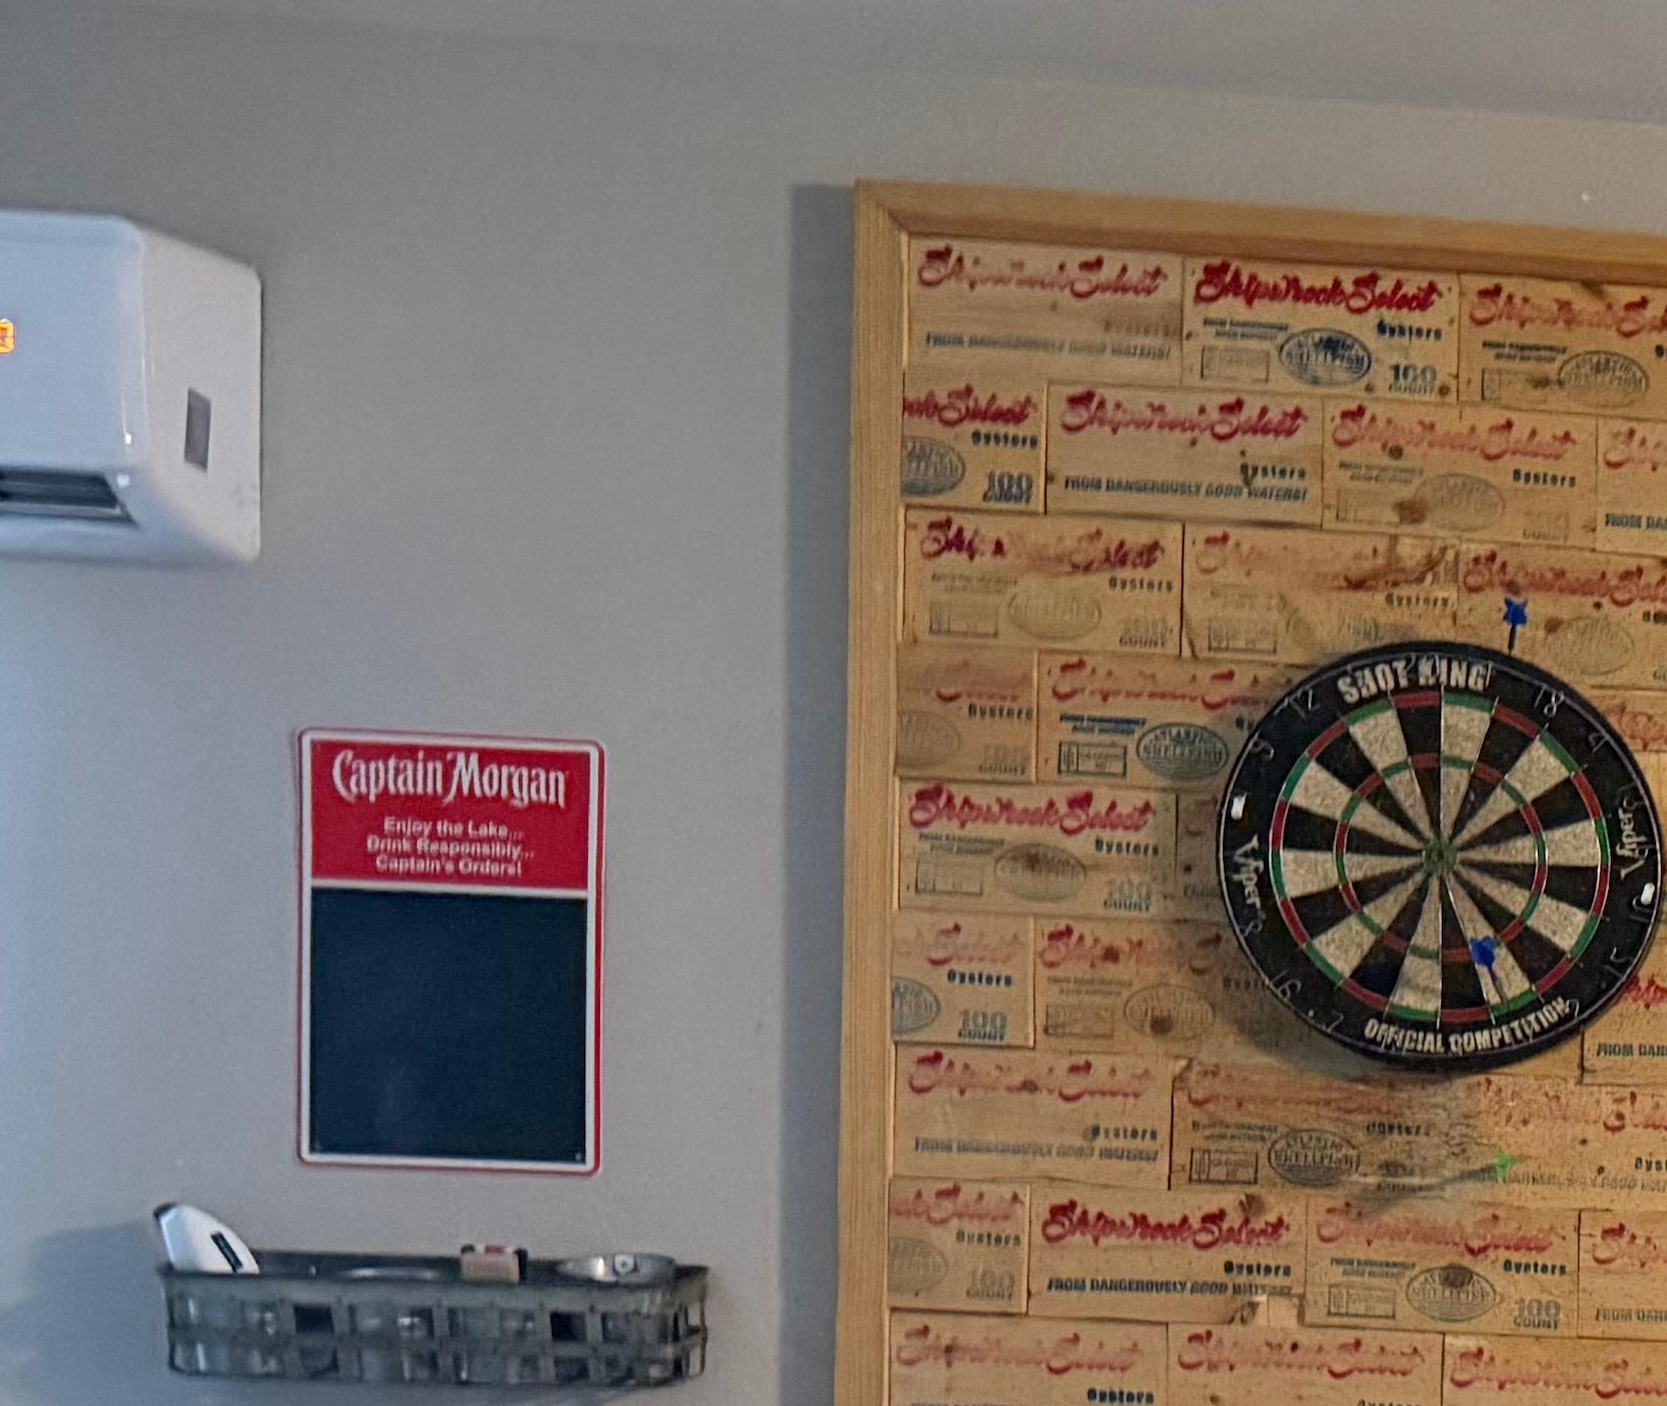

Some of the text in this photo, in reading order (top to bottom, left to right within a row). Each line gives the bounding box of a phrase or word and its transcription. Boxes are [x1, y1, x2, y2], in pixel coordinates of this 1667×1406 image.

[1337, 657, 1487, 704] SHOT KING
[332, 750, 567, 809] Captain Morgan
[367, 834, 411, 852] Drink
[384, 816, 432, 837] Enjoy
[436, 819, 463, 835] the
[376, 855, 522, 877] Captain's Orders!
[1364, 997, 1570, 1058] OFFICIAL COMPETITION
